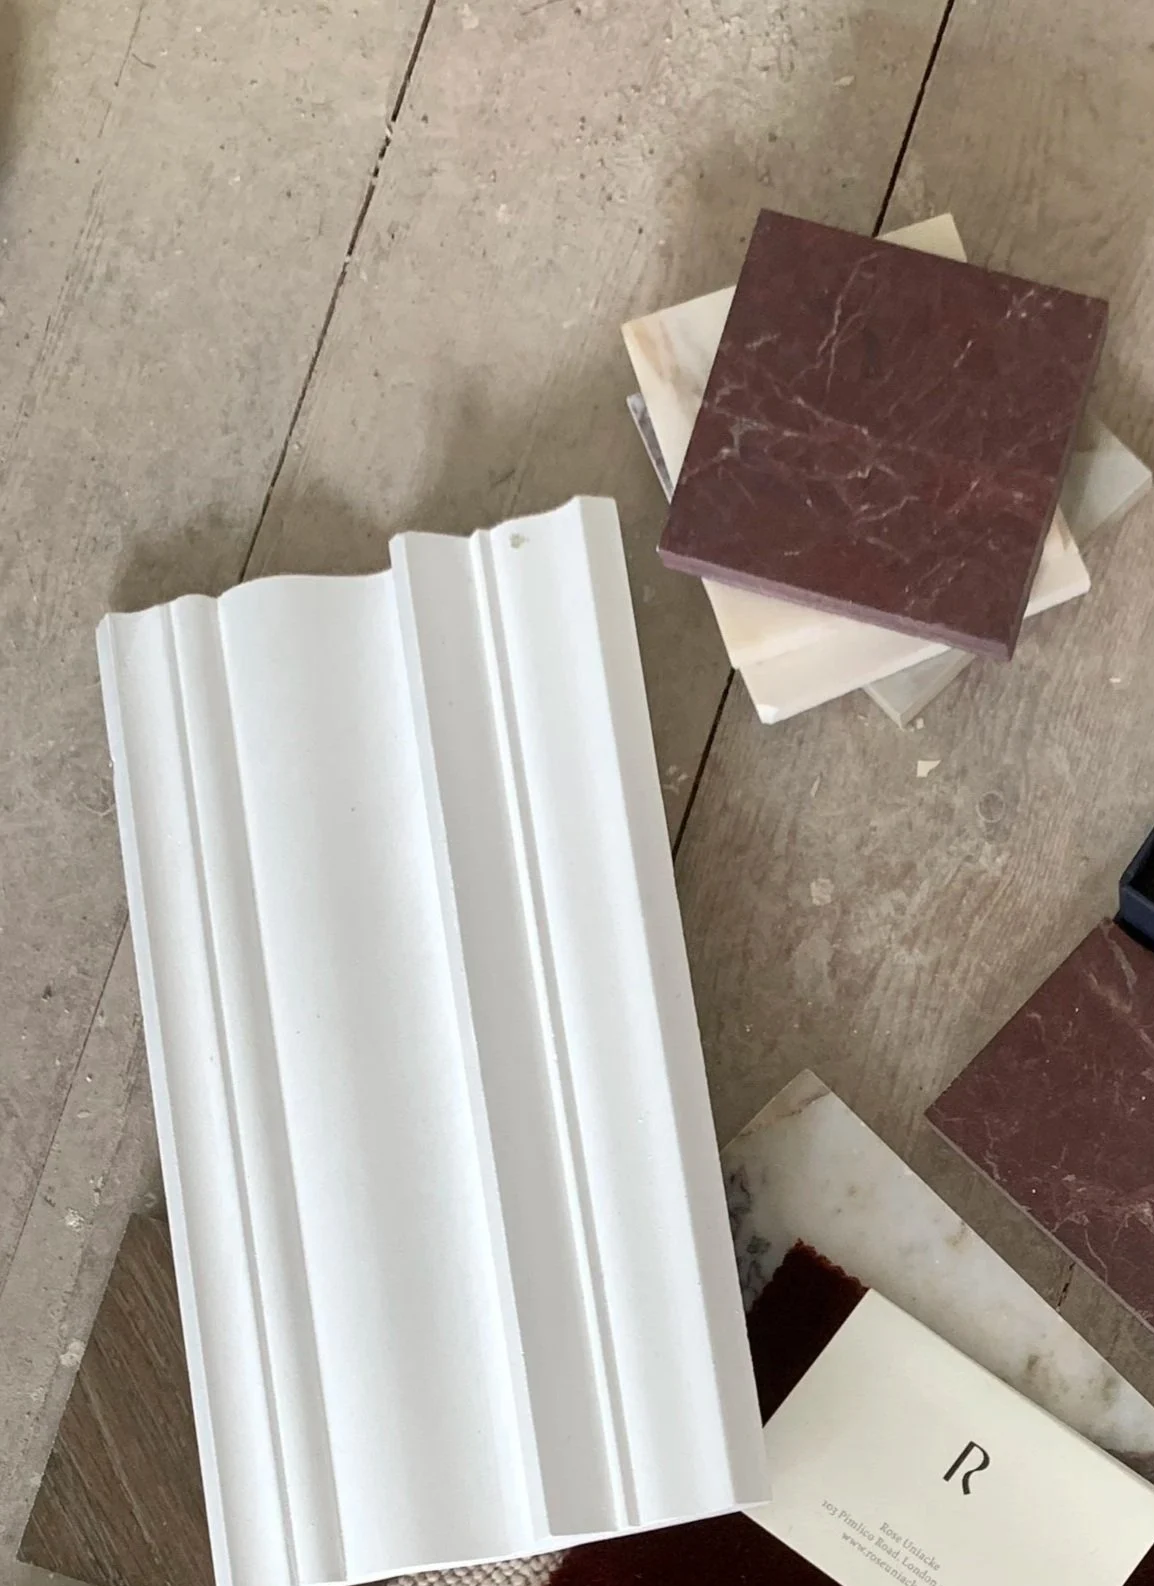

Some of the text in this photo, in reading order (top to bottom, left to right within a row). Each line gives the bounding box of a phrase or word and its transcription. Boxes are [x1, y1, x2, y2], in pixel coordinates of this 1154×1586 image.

[943, 1440, 990, 1495] R
[821, 1500, 838, 1516] 103
[837, 1510, 875, 1542] Pimlico
[879, 1521, 941, 1571] Rose Uniacke
